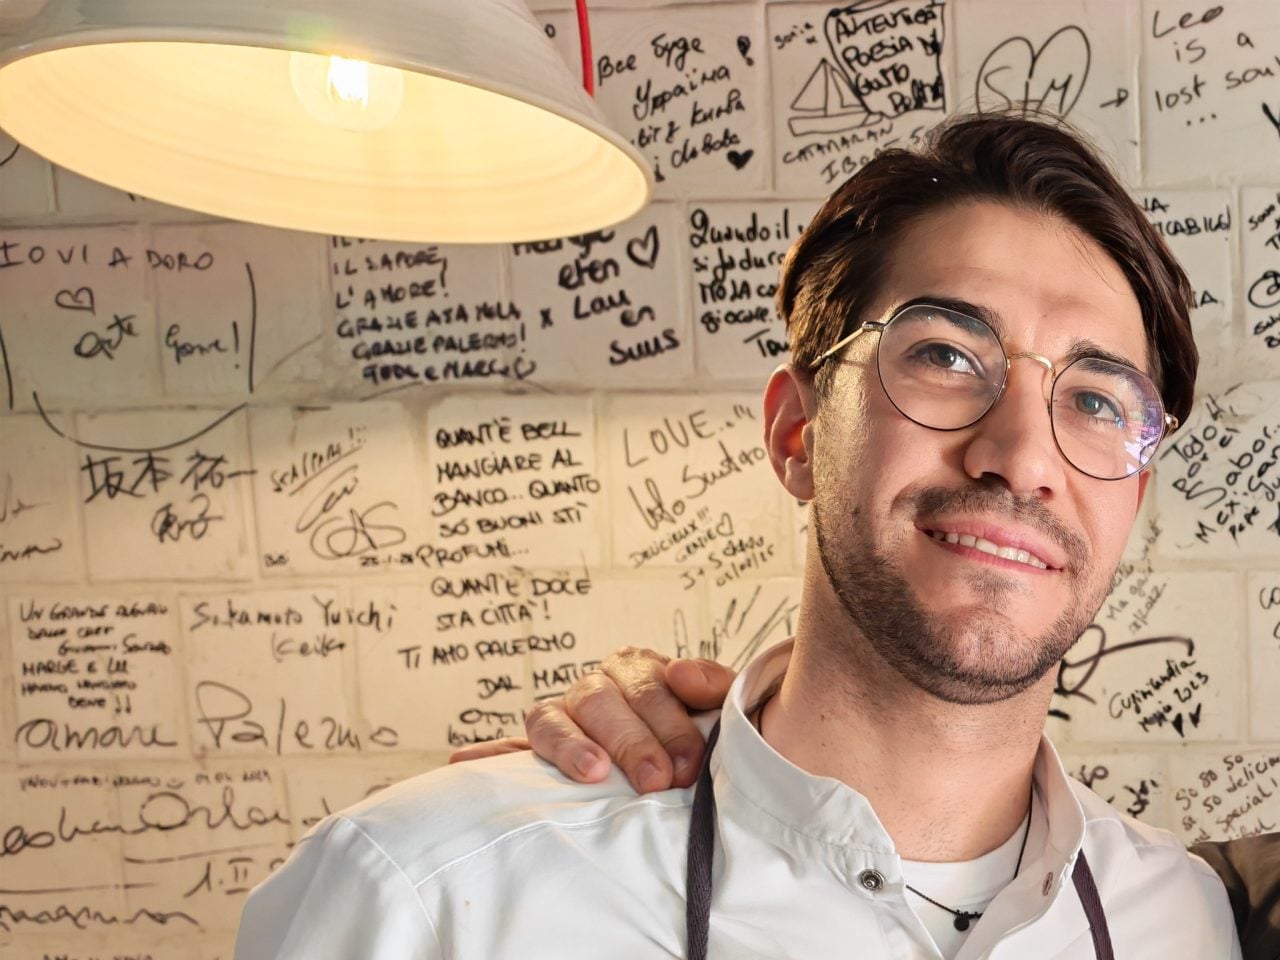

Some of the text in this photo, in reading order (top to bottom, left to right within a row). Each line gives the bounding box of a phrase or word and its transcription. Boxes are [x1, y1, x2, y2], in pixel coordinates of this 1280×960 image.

[1174, 32, 1254, 63] is a
[1155, 75, 1206, 112] lost
[690, 208, 789, 248] Quando il
[621, 306, 655, 327] en
[436, 449, 584, 484] MANGIARE AL
[529, 475, 601, 500] QUANTO
[478, 511, 543, 534] BUONI
[432, 644, 469, 665] AMO
[475, 631, 575, 660] PALERMO
